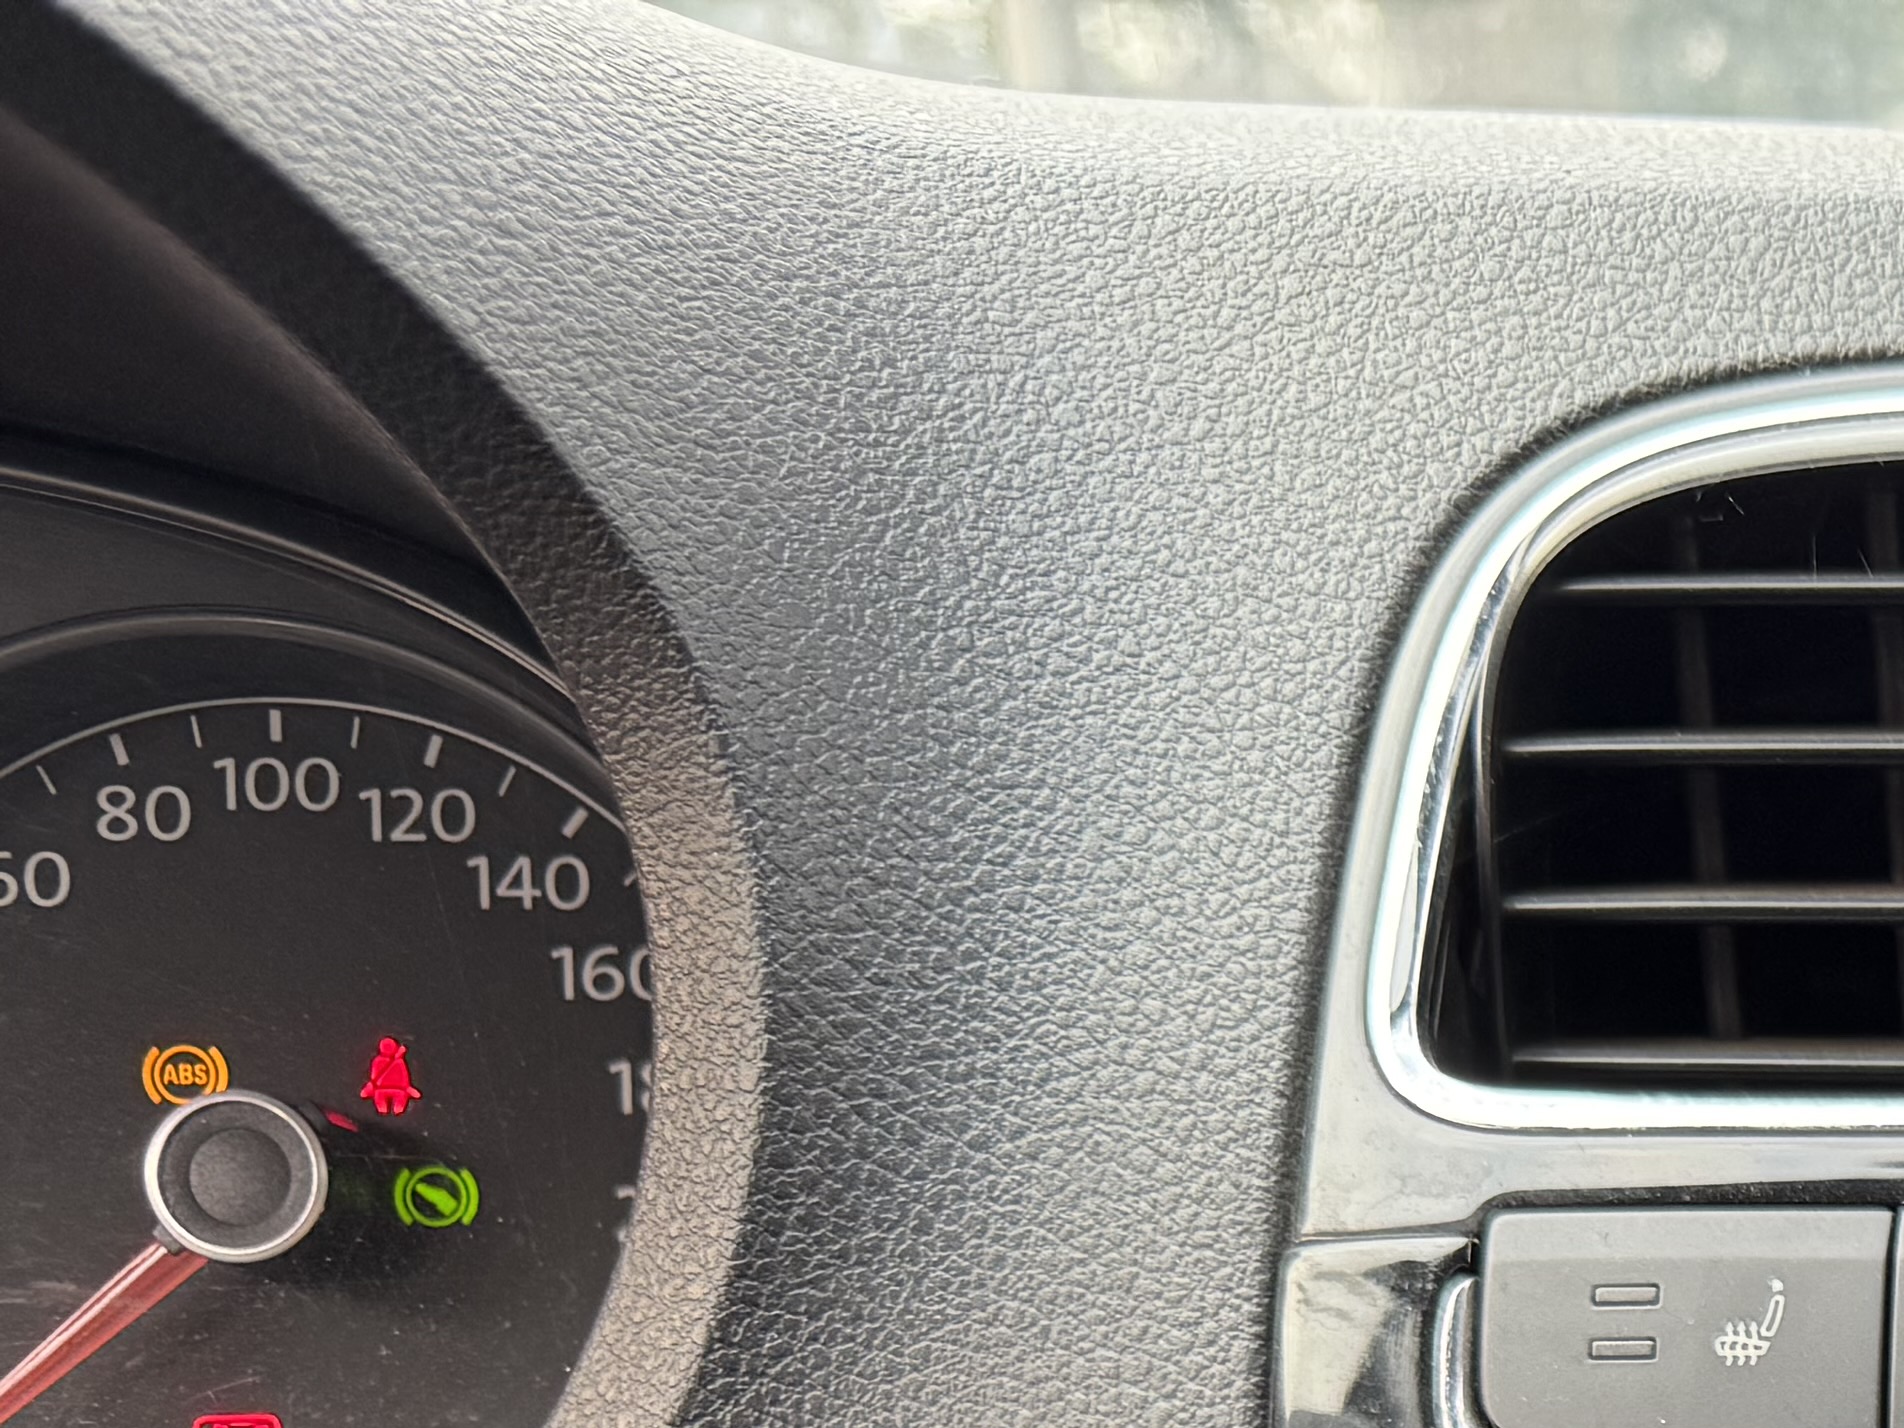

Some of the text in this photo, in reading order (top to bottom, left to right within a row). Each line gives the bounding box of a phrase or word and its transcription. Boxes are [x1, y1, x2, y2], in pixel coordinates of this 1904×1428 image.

[214, 758, 339, 811] 100
[97, 785, 190, 841] 80
[359, 788, 475, 842] 120
[467, 856, 589, 910] 140
[163, 1060, 208, 1087] ABS
